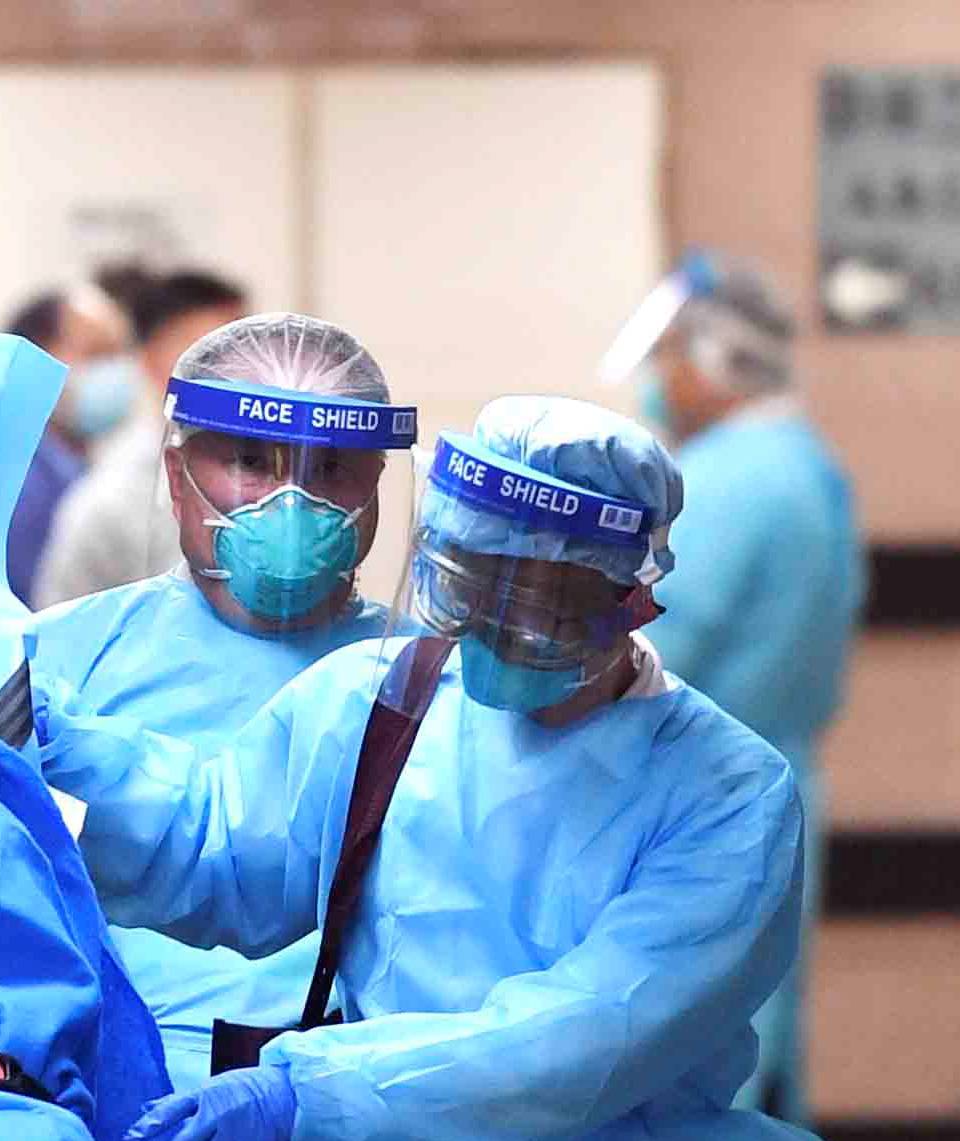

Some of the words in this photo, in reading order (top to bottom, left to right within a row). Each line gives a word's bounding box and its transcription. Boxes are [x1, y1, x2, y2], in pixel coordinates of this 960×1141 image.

[238, 397, 294, 424] FACE
[311, 407, 379, 431] SHIELD
[448, 451, 488, 486] FACE
[499, 475, 579, 515] SHIELD
